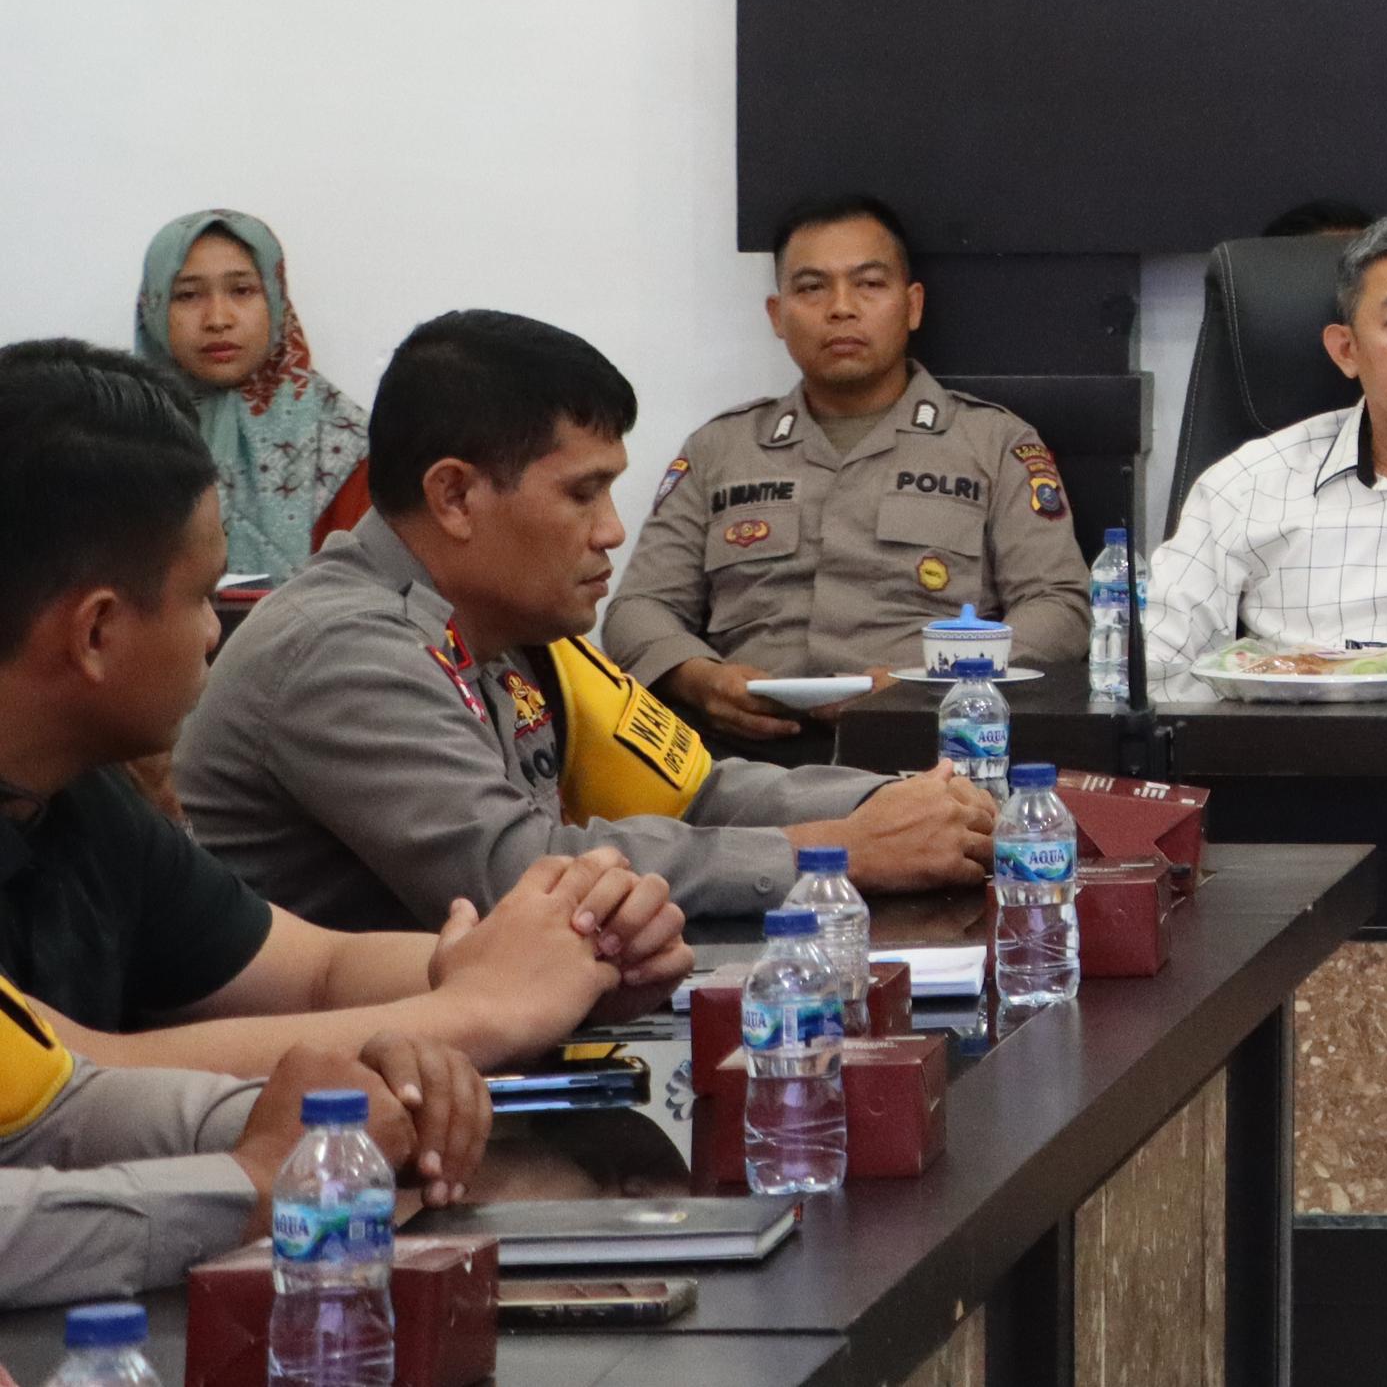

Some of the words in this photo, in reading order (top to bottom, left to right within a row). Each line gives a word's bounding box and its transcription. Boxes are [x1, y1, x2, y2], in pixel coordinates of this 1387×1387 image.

[896, 471, 981, 502] POLRI
[977, 729, 1008, 745] AQUA
[1028, 849, 1067, 866] AQUA
